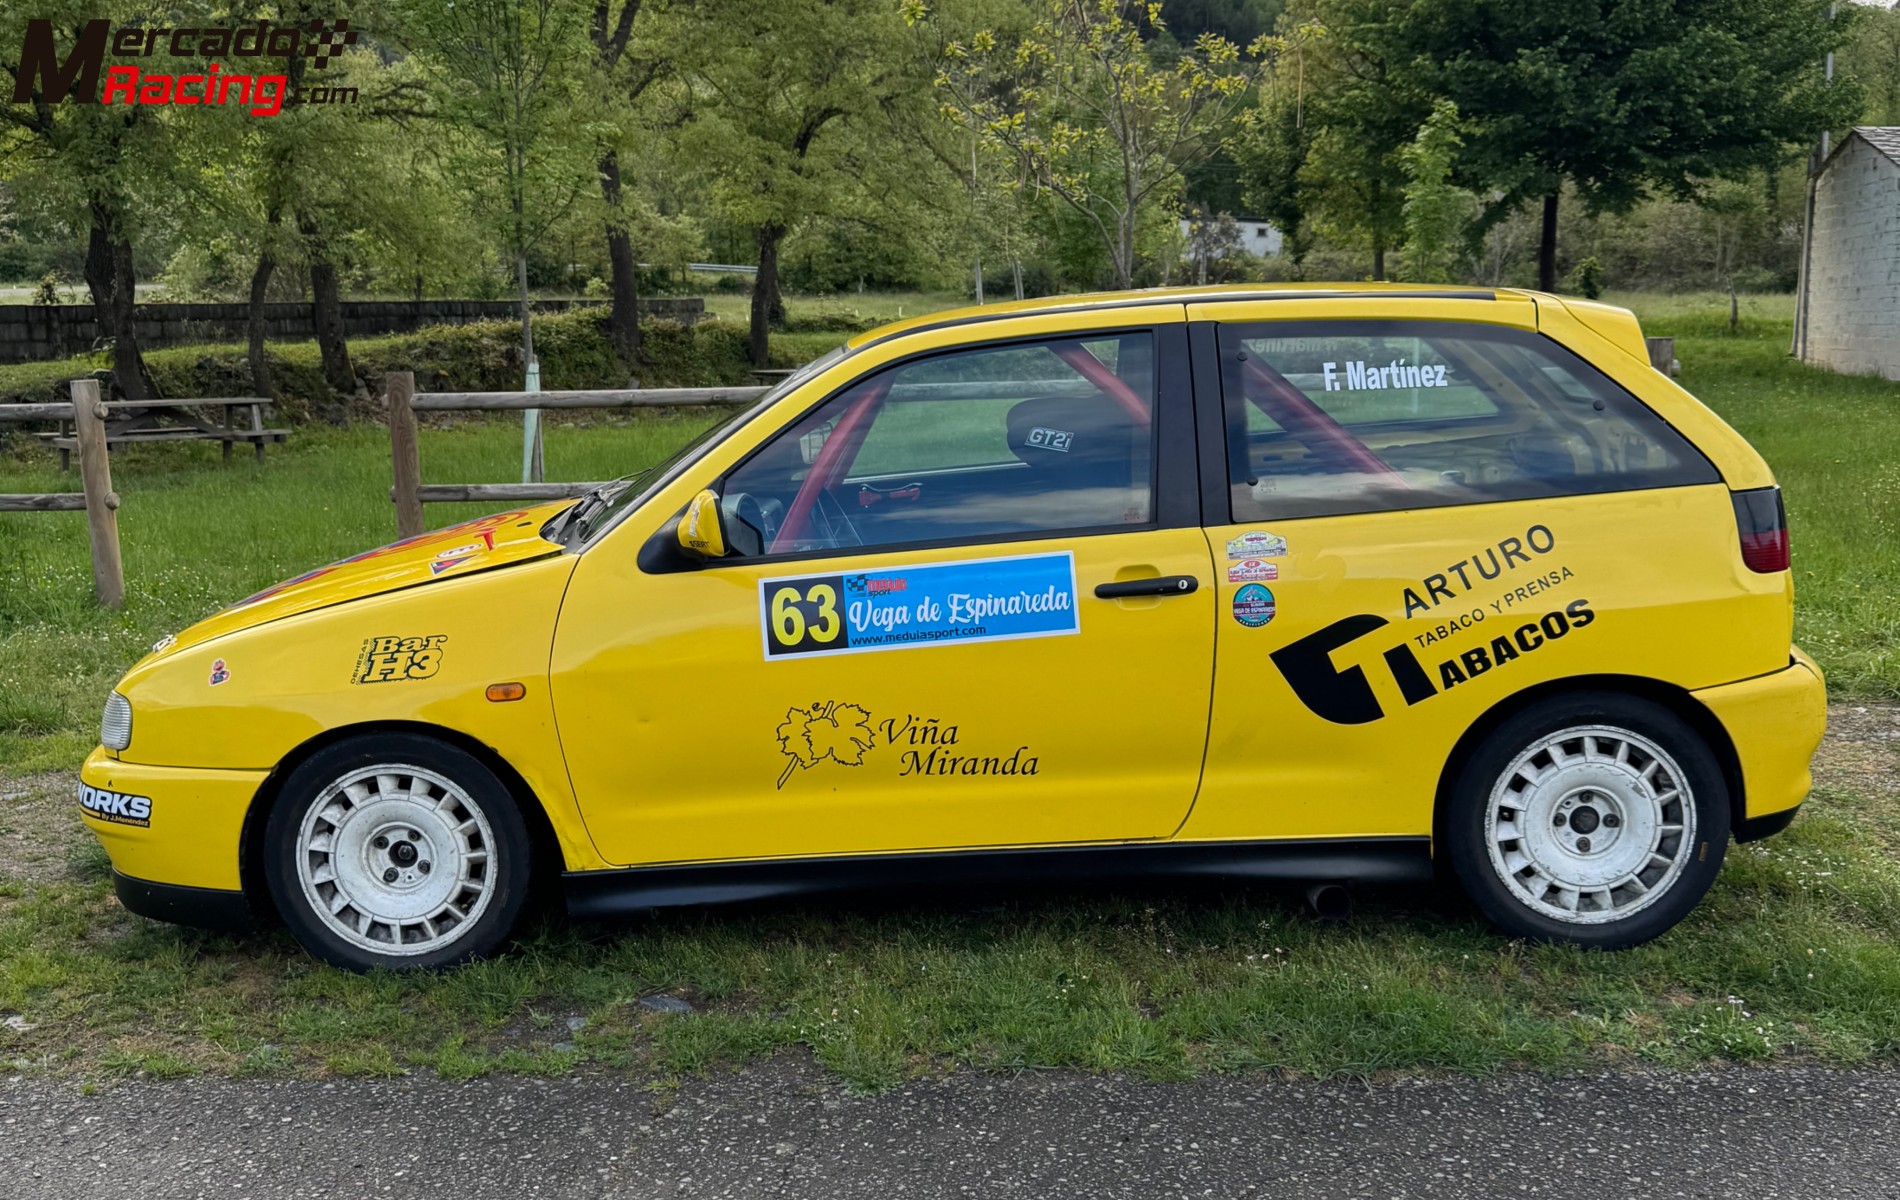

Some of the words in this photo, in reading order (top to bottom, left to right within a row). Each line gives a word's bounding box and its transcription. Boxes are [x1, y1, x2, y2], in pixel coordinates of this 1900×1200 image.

[1323, 361, 1341, 392] F.
[1345, 358, 1449, 391] Martínez
[1029, 428, 1073, 448] GT2i
[1402, 524, 1555, 619] ARTURO
[771, 584, 841, 646] 63
[849, 600, 911, 632] Vega
[916, 595, 942, 623] de
[947, 584, 1071, 624] Espinareda
[1414, 607, 1486, 649] TABACO
[1489, 600, 1503, 614] Y
[1503, 565, 1575, 608] PRENSA
[372, 634, 449, 656] Bar
[360, 647, 444, 684] H3
[878, 713, 960, 746] Viña
[898, 746, 1041, 777] Miranda
